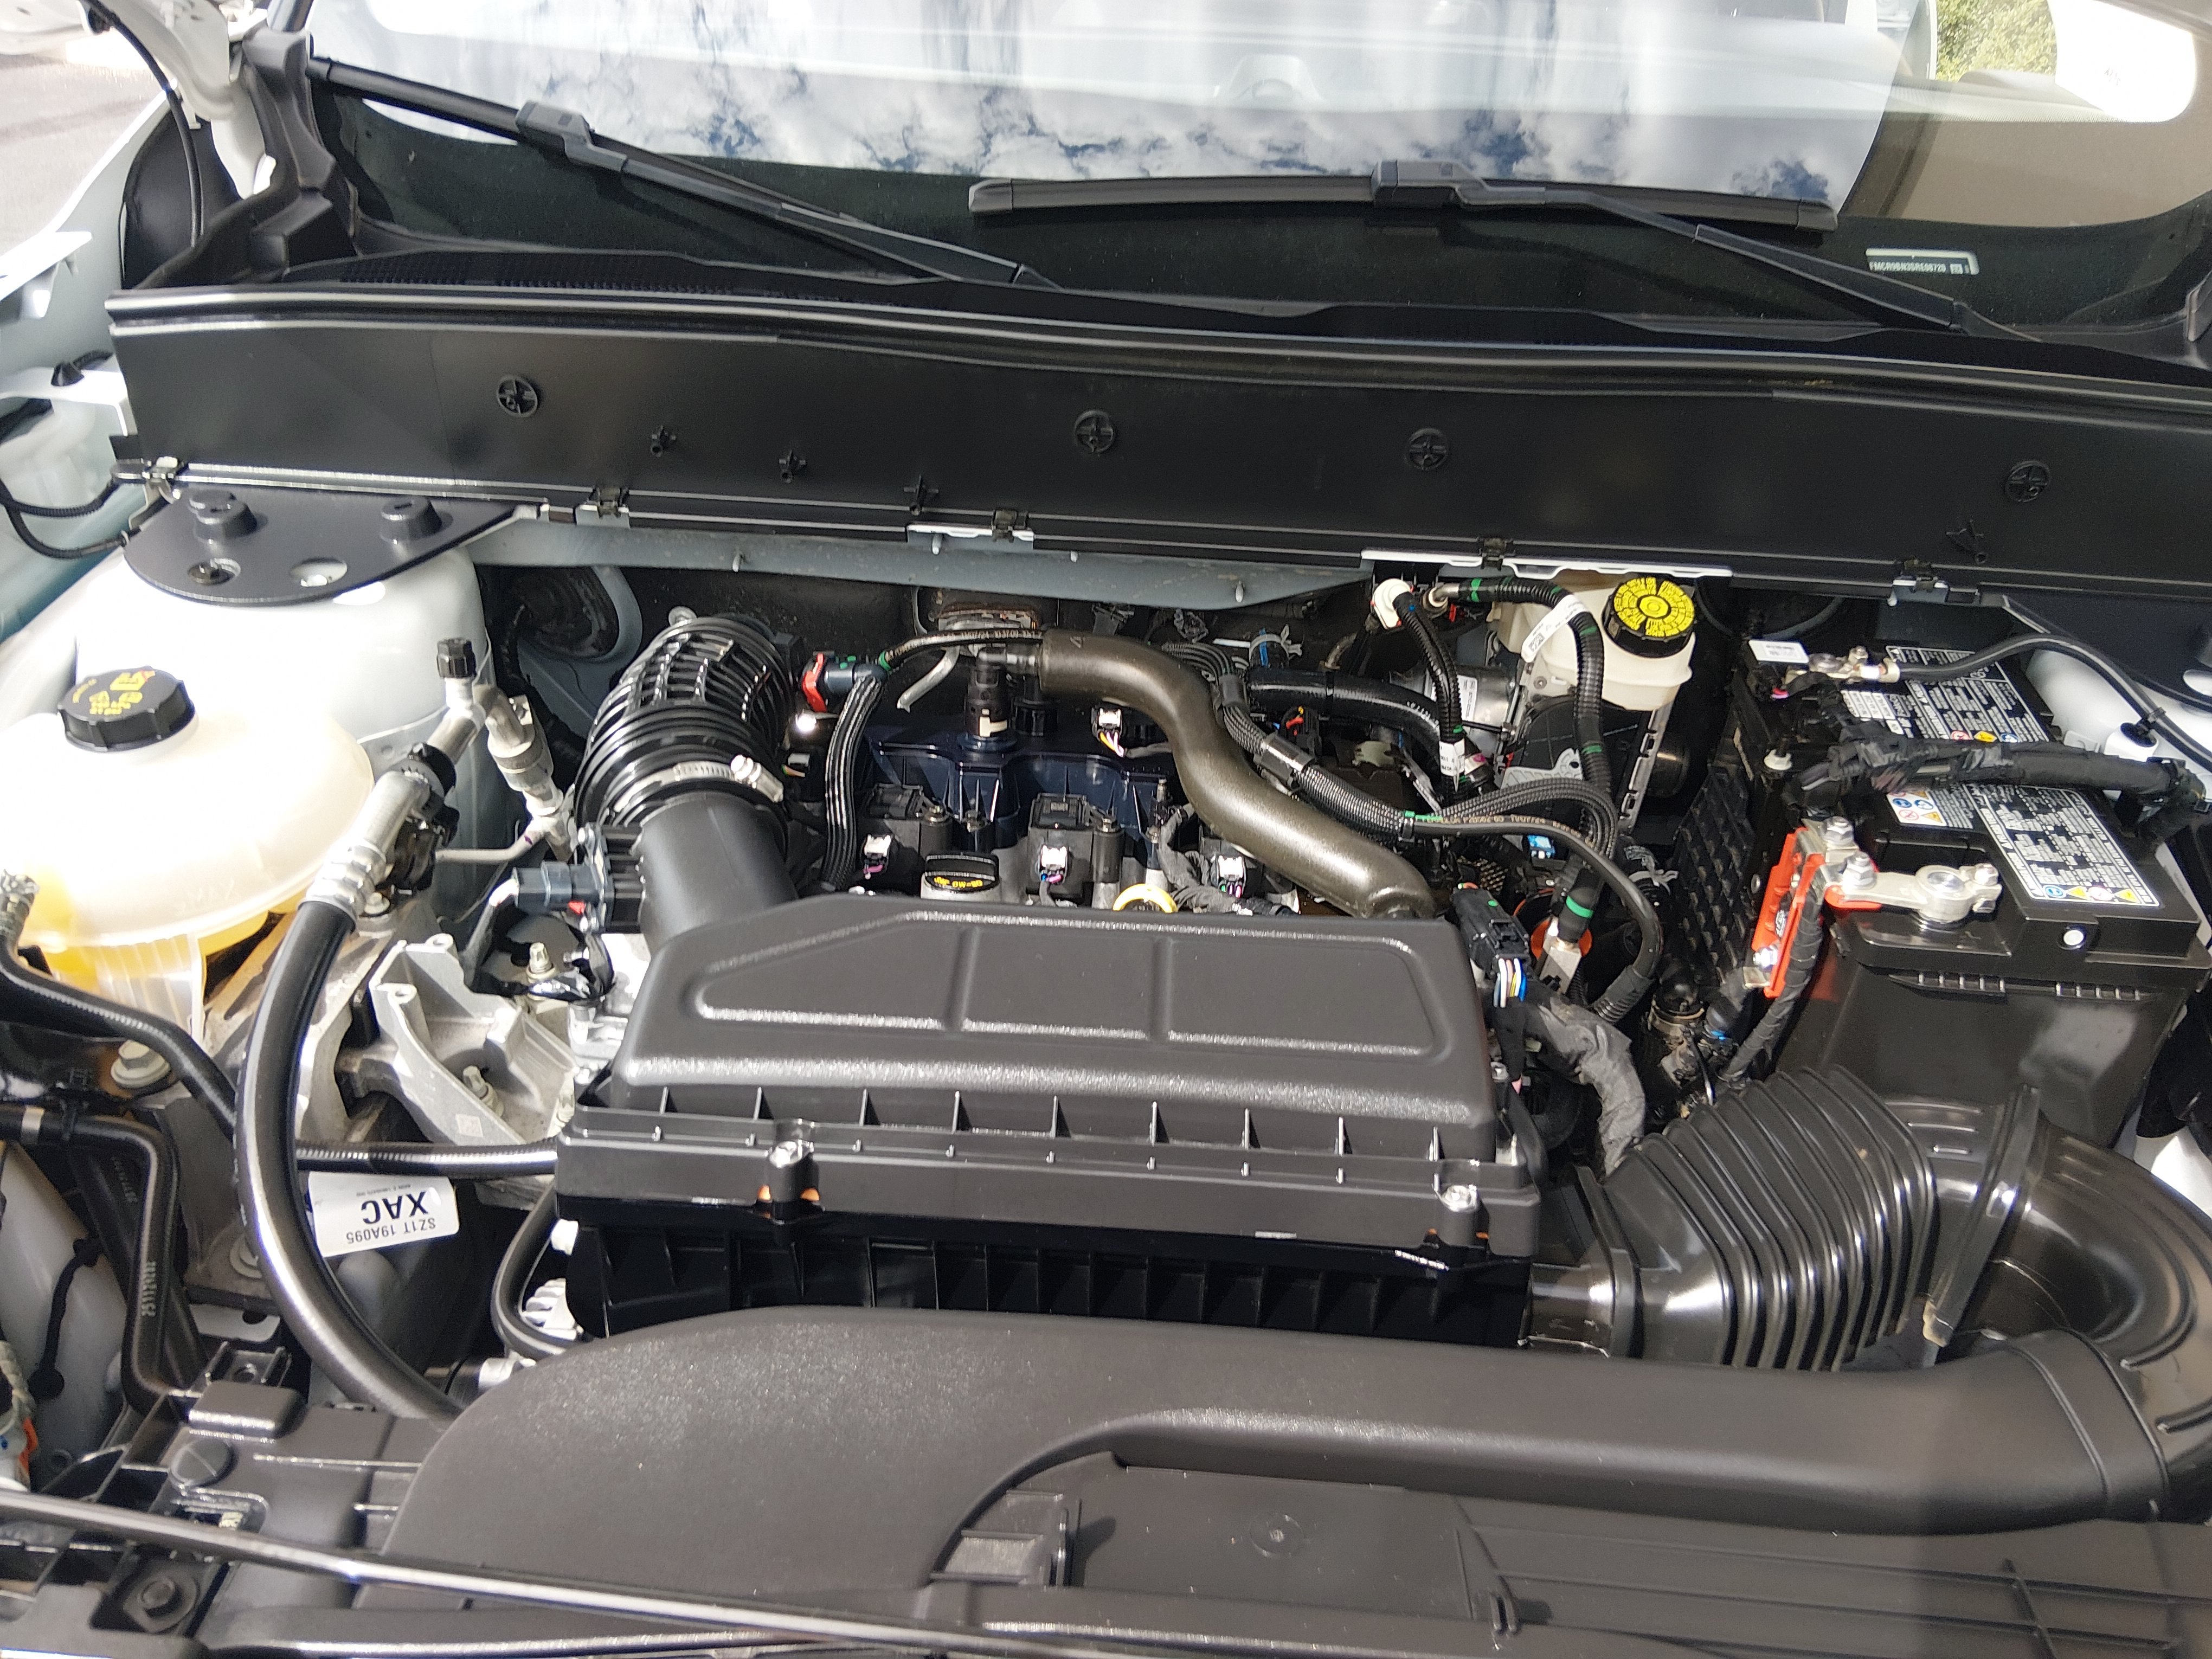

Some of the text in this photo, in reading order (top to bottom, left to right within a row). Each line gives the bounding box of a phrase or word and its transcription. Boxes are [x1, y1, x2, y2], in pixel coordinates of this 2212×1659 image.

[361, 1190, 428, 1224] XAC
[346, 1218, 436, 1244] SZ1T 19A095
